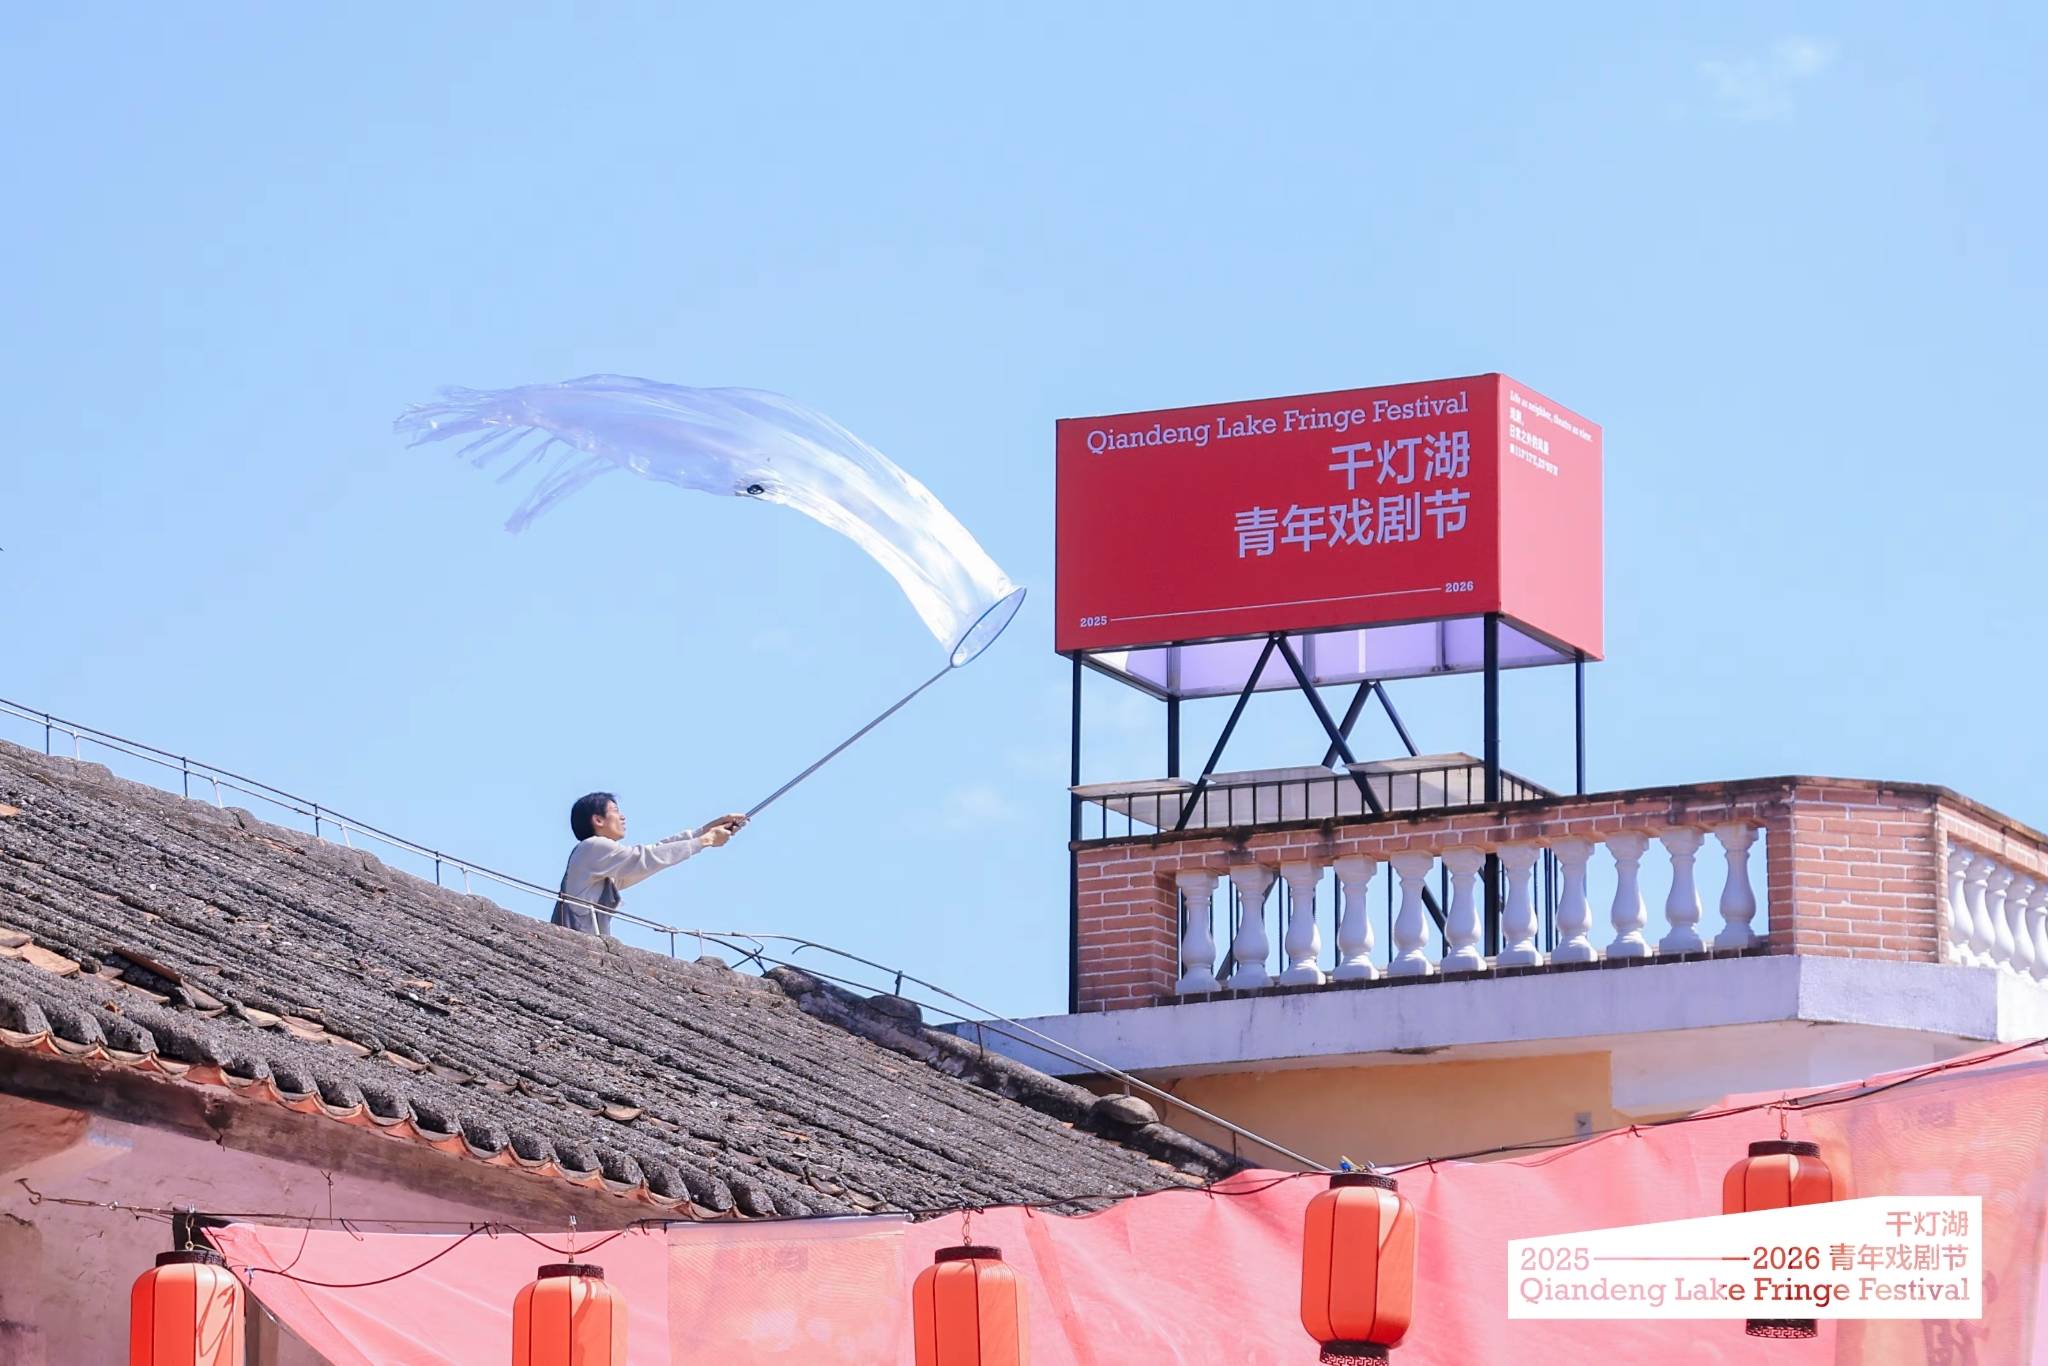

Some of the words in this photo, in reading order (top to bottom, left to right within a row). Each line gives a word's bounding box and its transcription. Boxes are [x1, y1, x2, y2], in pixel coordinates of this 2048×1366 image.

[1086, 424, 1211, 455] Qiandeng
[1217, 414, 1277, 438] Lake
[1283, 408, 1366, 433] Fringe
[1372, 391, 1469, 423] Festival
[1328, 428, 1471, 491] 千灯湖
[1233, 487, 1471, 559] 青年戏剧节
[1080, 615, 1108, 628] 2025
[1445, 580, 1474, 593] 2026
